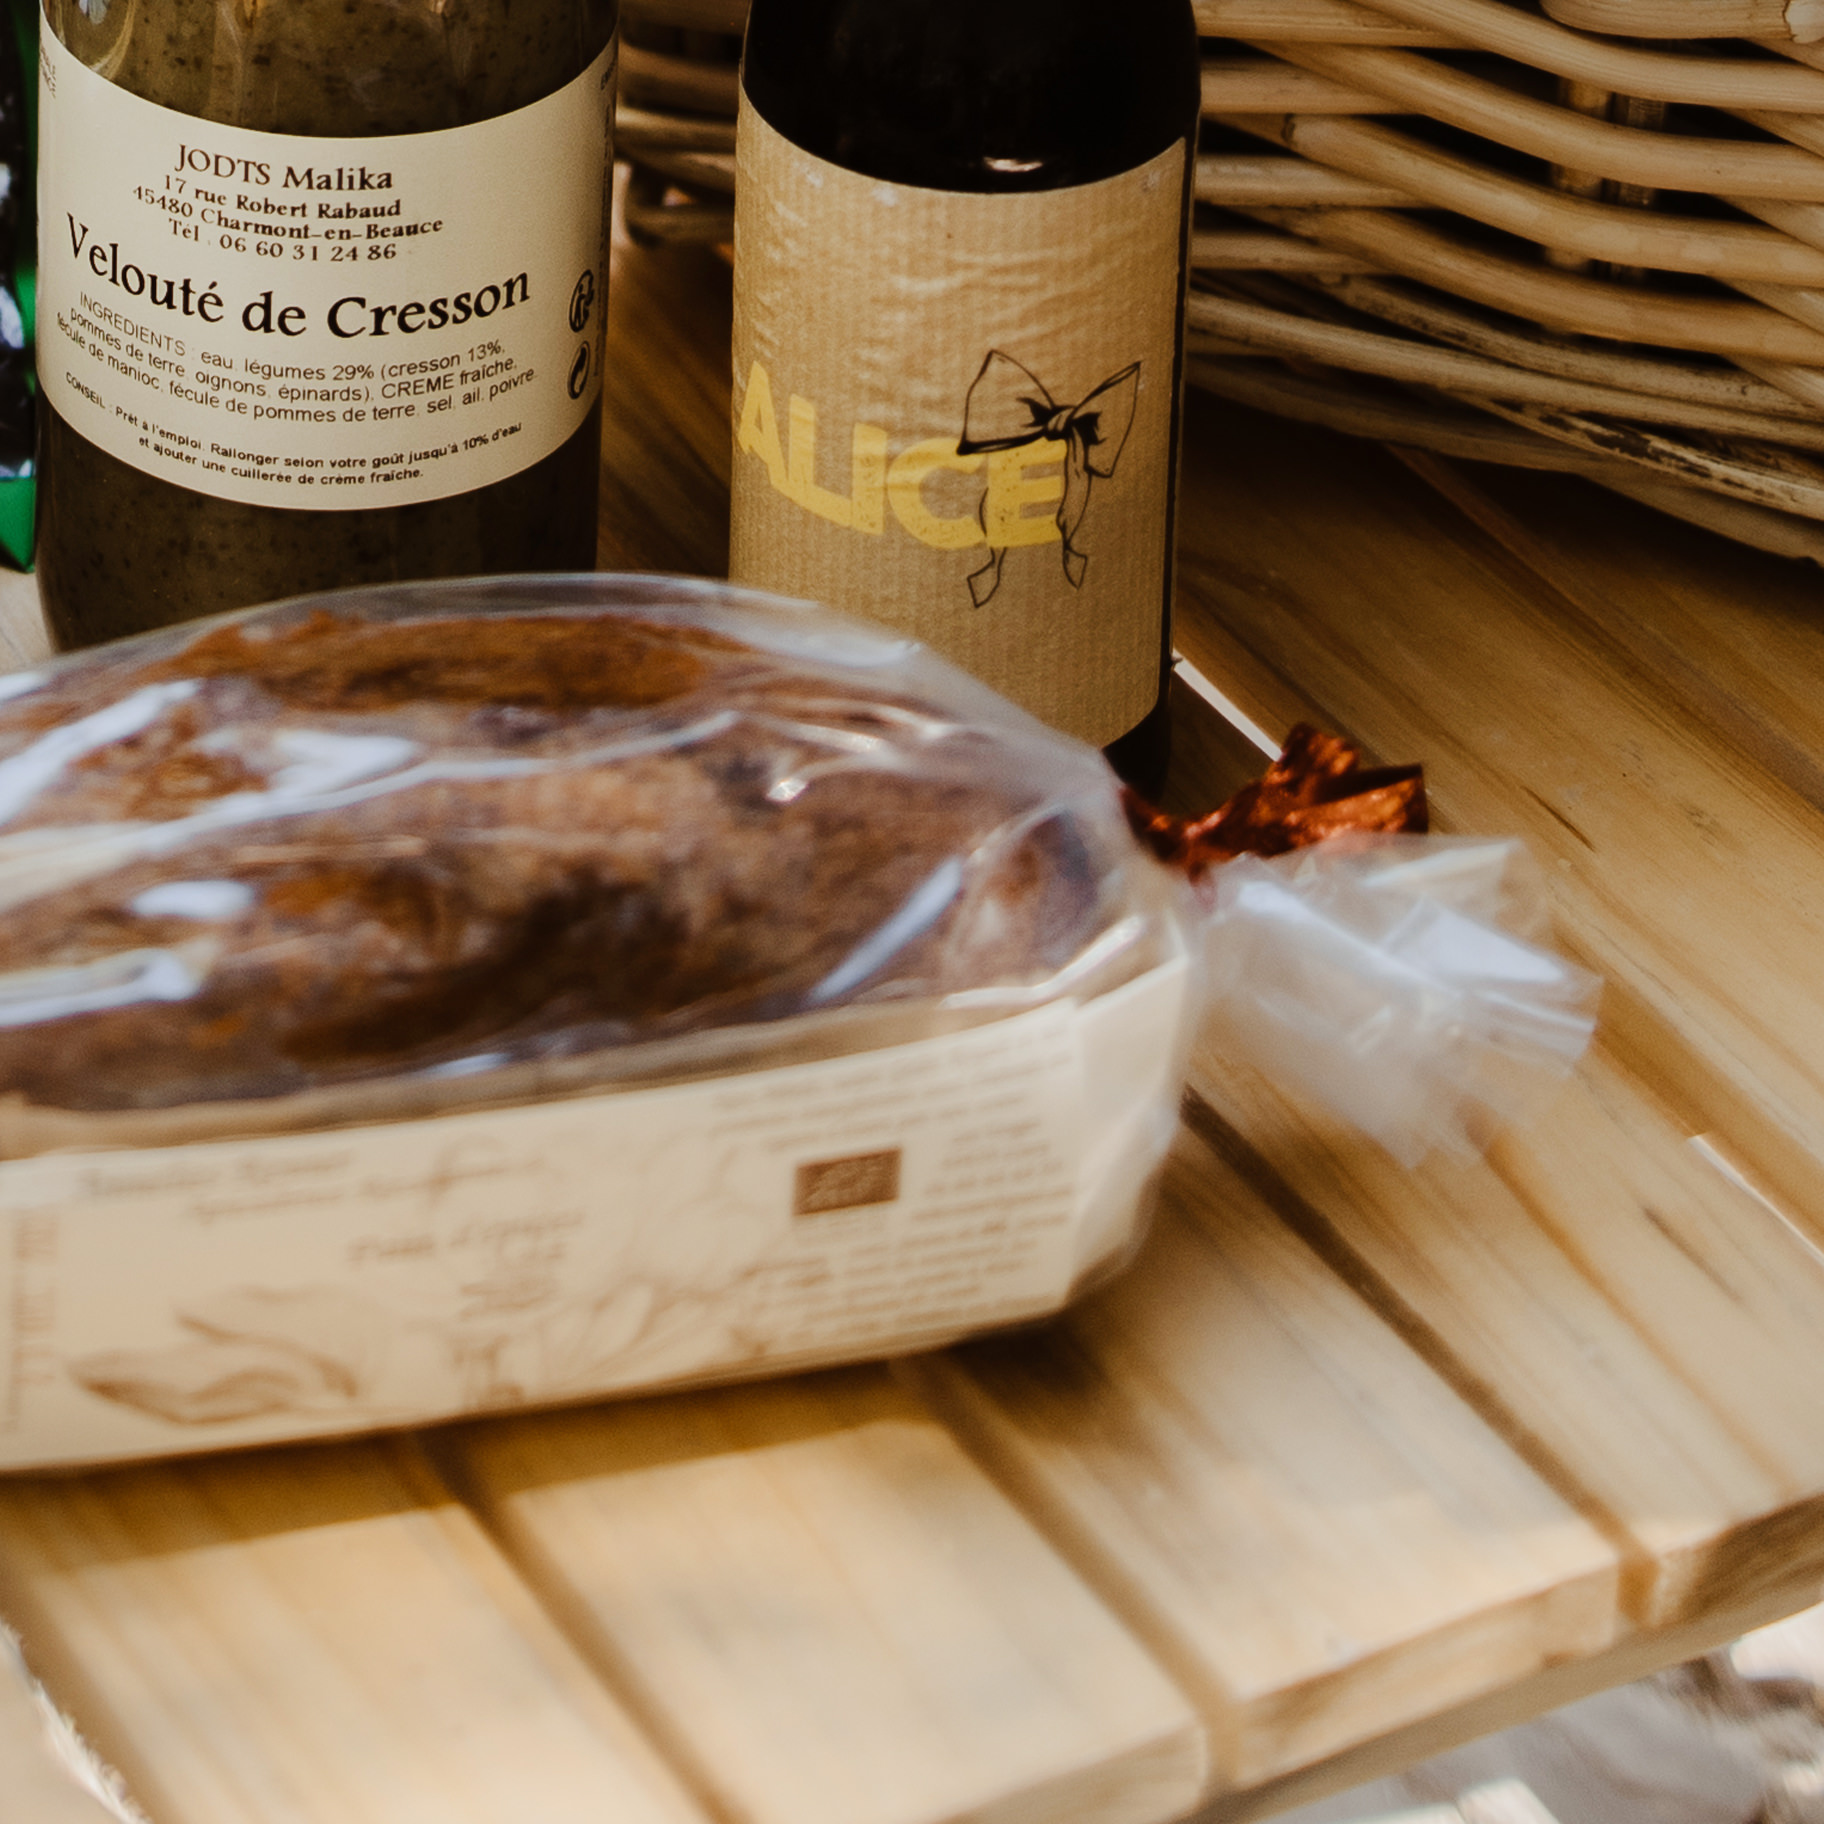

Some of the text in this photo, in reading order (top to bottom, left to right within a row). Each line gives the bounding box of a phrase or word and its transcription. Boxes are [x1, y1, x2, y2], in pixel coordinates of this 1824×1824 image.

[133, 185, 443, 240] 45480 Charmont-en-Beauce
[164, 175, 401, 219] 17 rue Robert Rabaud
[174, 144, 393, 191] JODTS Malika
[67, 211, 530, 338] Velouté de Cresson
[168, 218, 199, 241] Tél
[220, 234, 247, 253] 06
[256, 241, 283, 258] 60
[293, 245, 318, 261] 31
[330, 245, 359, 262] 24
[367, 243, 397, 260] 86
[57, 311, 86, 349] fécule
[88, 341, 104, 361] de
[169, 380, 219, 408] fécule
[225, 397, 247, 414] de
[254, 404, 336, 424] pommes
[342, 406, 366, 422] de
[70, 307, 122, 352] pommes
[126, 342, 144, 361] de
[381, 373, 454, 399] CREME
[80, 291, 186, 357] INGREDIENTS
[244, 358, 326, 380] légumes
[332, 364, 374, 381] 29%
[380, 353, 461, 380] (cresson
[65, 371, 107, 410] CONSEIL
[115, 405, 139, 427] Prêt
[142, 421, 149, 432] à
[210, 443, 279, 466] Rallonger
[284, 457, 324, 468] selon
[330, 458, 367, 469] votre
[372, 452, 404, 469] goût
[408, 443, 459, 465] jusqu'à
[463, 435, 489, 451] 10%
[491, 422, 522, 442] d'eau
[138, 435, 150, 449] et
[153, 443, 198, 465] ajouter
[202, 458, 226, 474] une
[231, 465, 292, 484] cuillerée
[298, 473, 314, 485] de
[320, 472, 365, 485] crème
[738, 359, 1068, 551] ALICE
